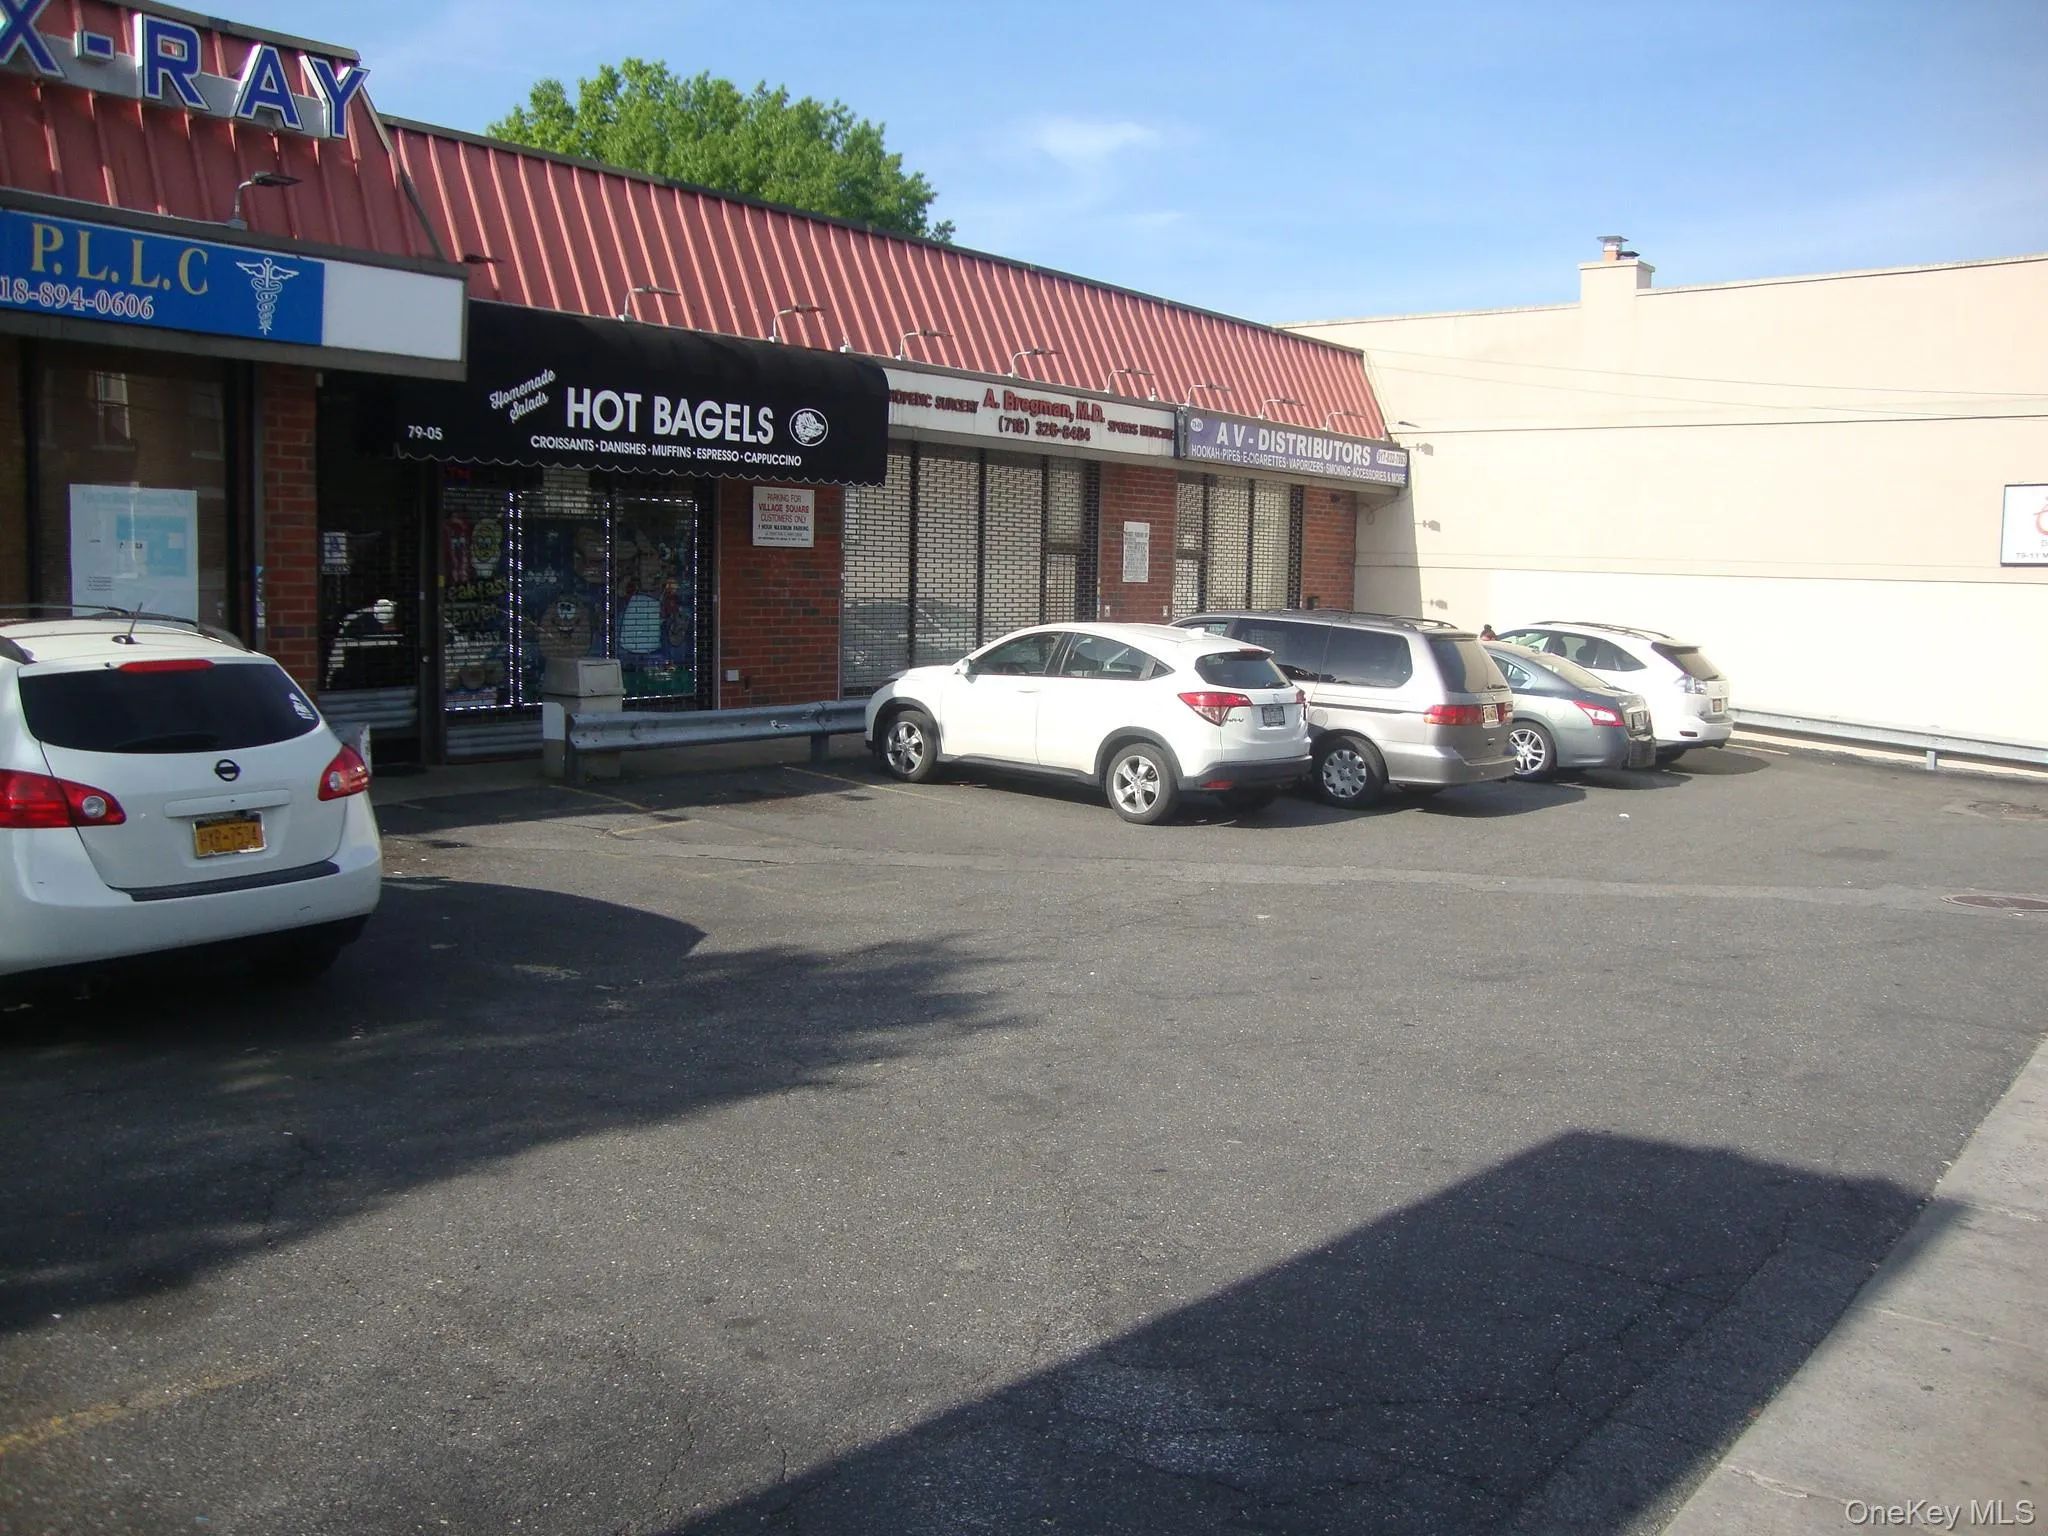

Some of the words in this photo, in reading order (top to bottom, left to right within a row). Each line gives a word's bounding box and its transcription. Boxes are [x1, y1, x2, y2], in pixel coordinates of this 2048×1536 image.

[0, 0, 370, 139] X-RAY
[31, 222, 209, 296] P.L.L.C
[489, 368, 557, 410] Homemade
[510, 391, 549, 423] Salads
[566, 386, 642, 433] HOT
[653, 395, 775, 445] BAGELS
[408, 425, 443, 441] 79-05
[1258, 428, 1371, 466] DISTRIBUTORS
[530, 435, 595, 452] CROISSANTS
[600, 440, 647, 456] DANISHES
[651, 444, 692, 459] MUFFINS
[696, 448, 740, 462] ESPRESSO
[743, 451, 802, 466] CAPPUCCINO
[1191, 444, 1221, 460] HOOKAH
[1222, 449, 1241, 462] PIPES
[758, 503, 783, 513] VILLAGE
[785, 505, 810, 514] SQUARE
[760, 514, 793, 523] CUSTOMERS
[794, 515, 807, 524] ONLY
